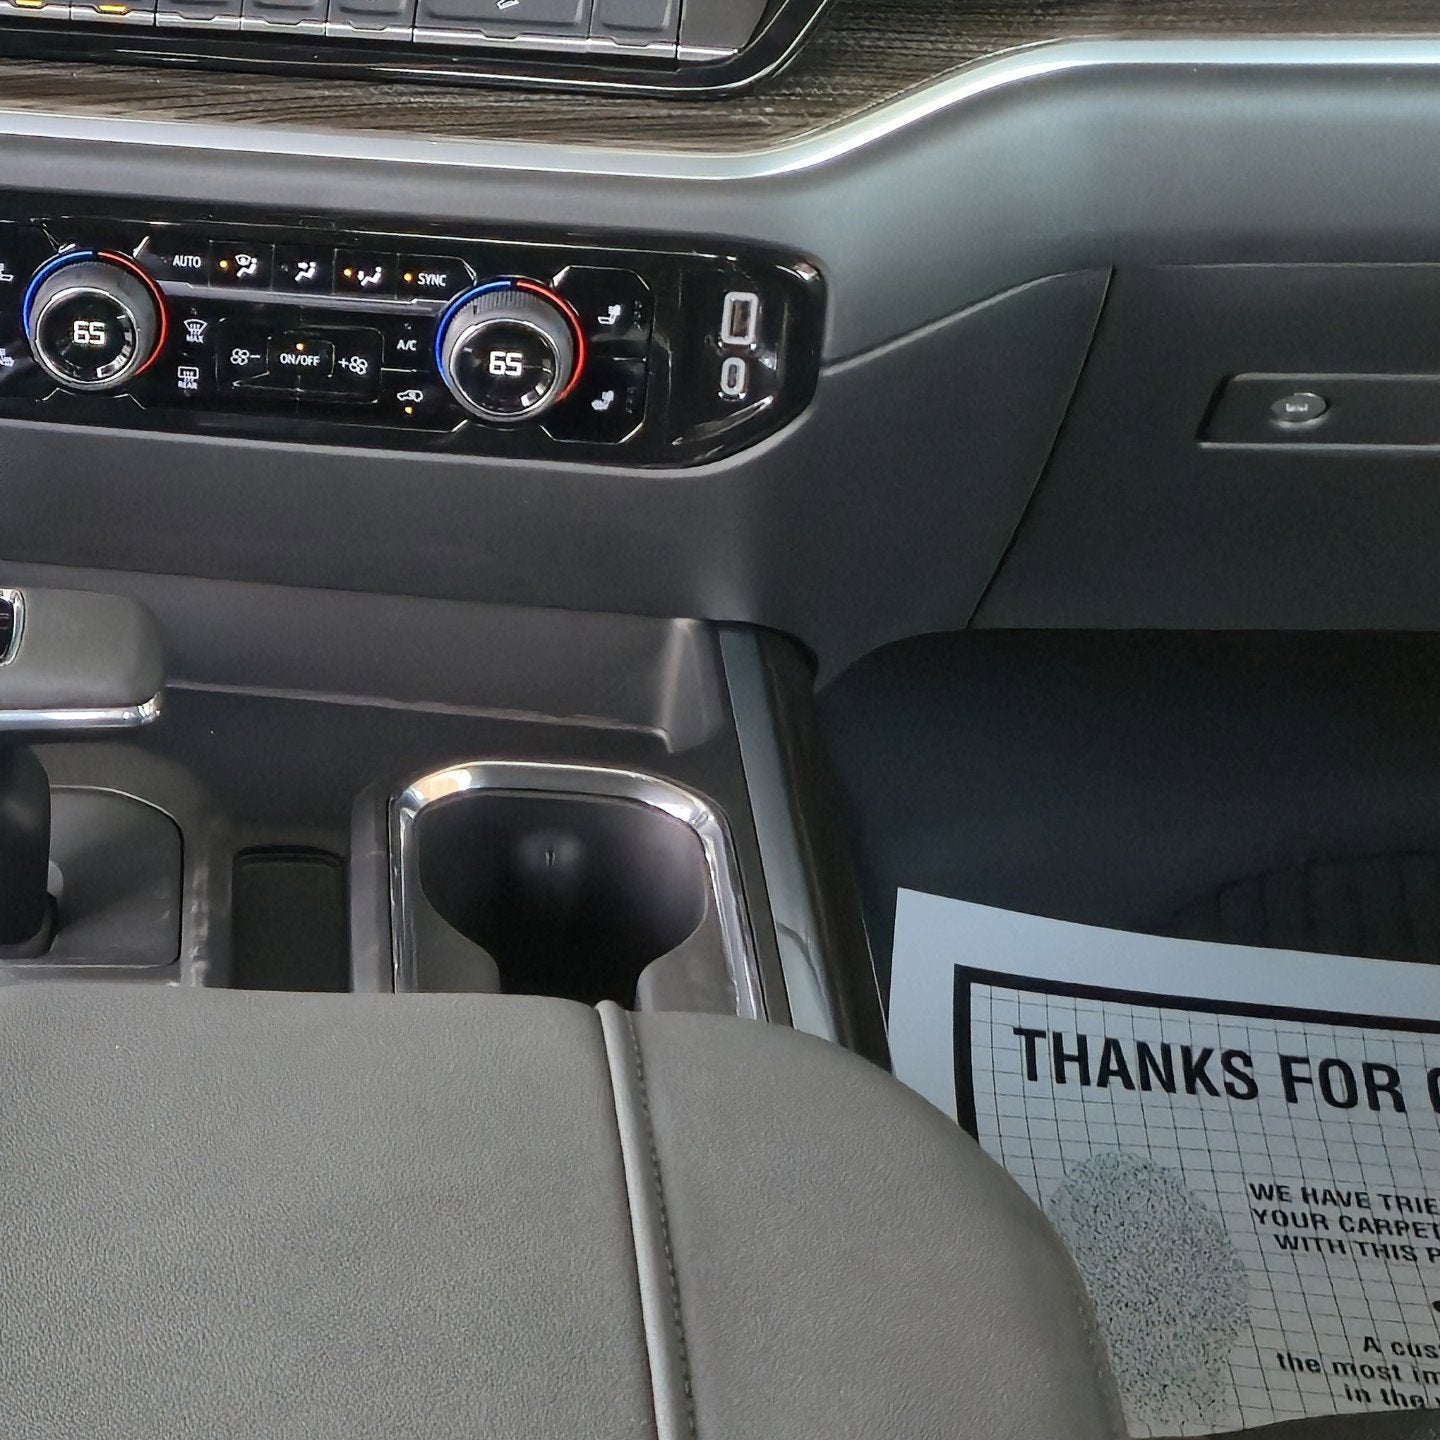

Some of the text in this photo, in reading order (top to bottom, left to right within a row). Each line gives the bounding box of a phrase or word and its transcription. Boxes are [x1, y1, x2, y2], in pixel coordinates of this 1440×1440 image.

[173, 255, 202, 268] AUTO
[418, 273, 447, 286] SYNC
[72, 321, 105, 344] 65
[186, 334, 204, 344] MAX
[396, 339, 417, 352] A/C
[279, 353, 320, 367] ON/OFF
[489, 351, 523, 376] 65
[1013, 1026, 1259, 1101] THANKS
[1280, 1053, 1407, 1113] FOR
[1249, 1183, 1292, 1203] WE
[1300, 1186, 1371, 1209] HAVE
[1251, 1208, 1330, 1230] YOUR
[1274, 1234, 1346, 1255] WITH
[1354, 1240, 1418, 1262] THIS
[1362, 1335, 1381, 1353] A
[1276, 1351, 1321, 1373] the
[1332, 1358, 1401, 1382] most
[1344, 1383, 1371, 1404] in
[1380, 1387, 1425, 1409] the
